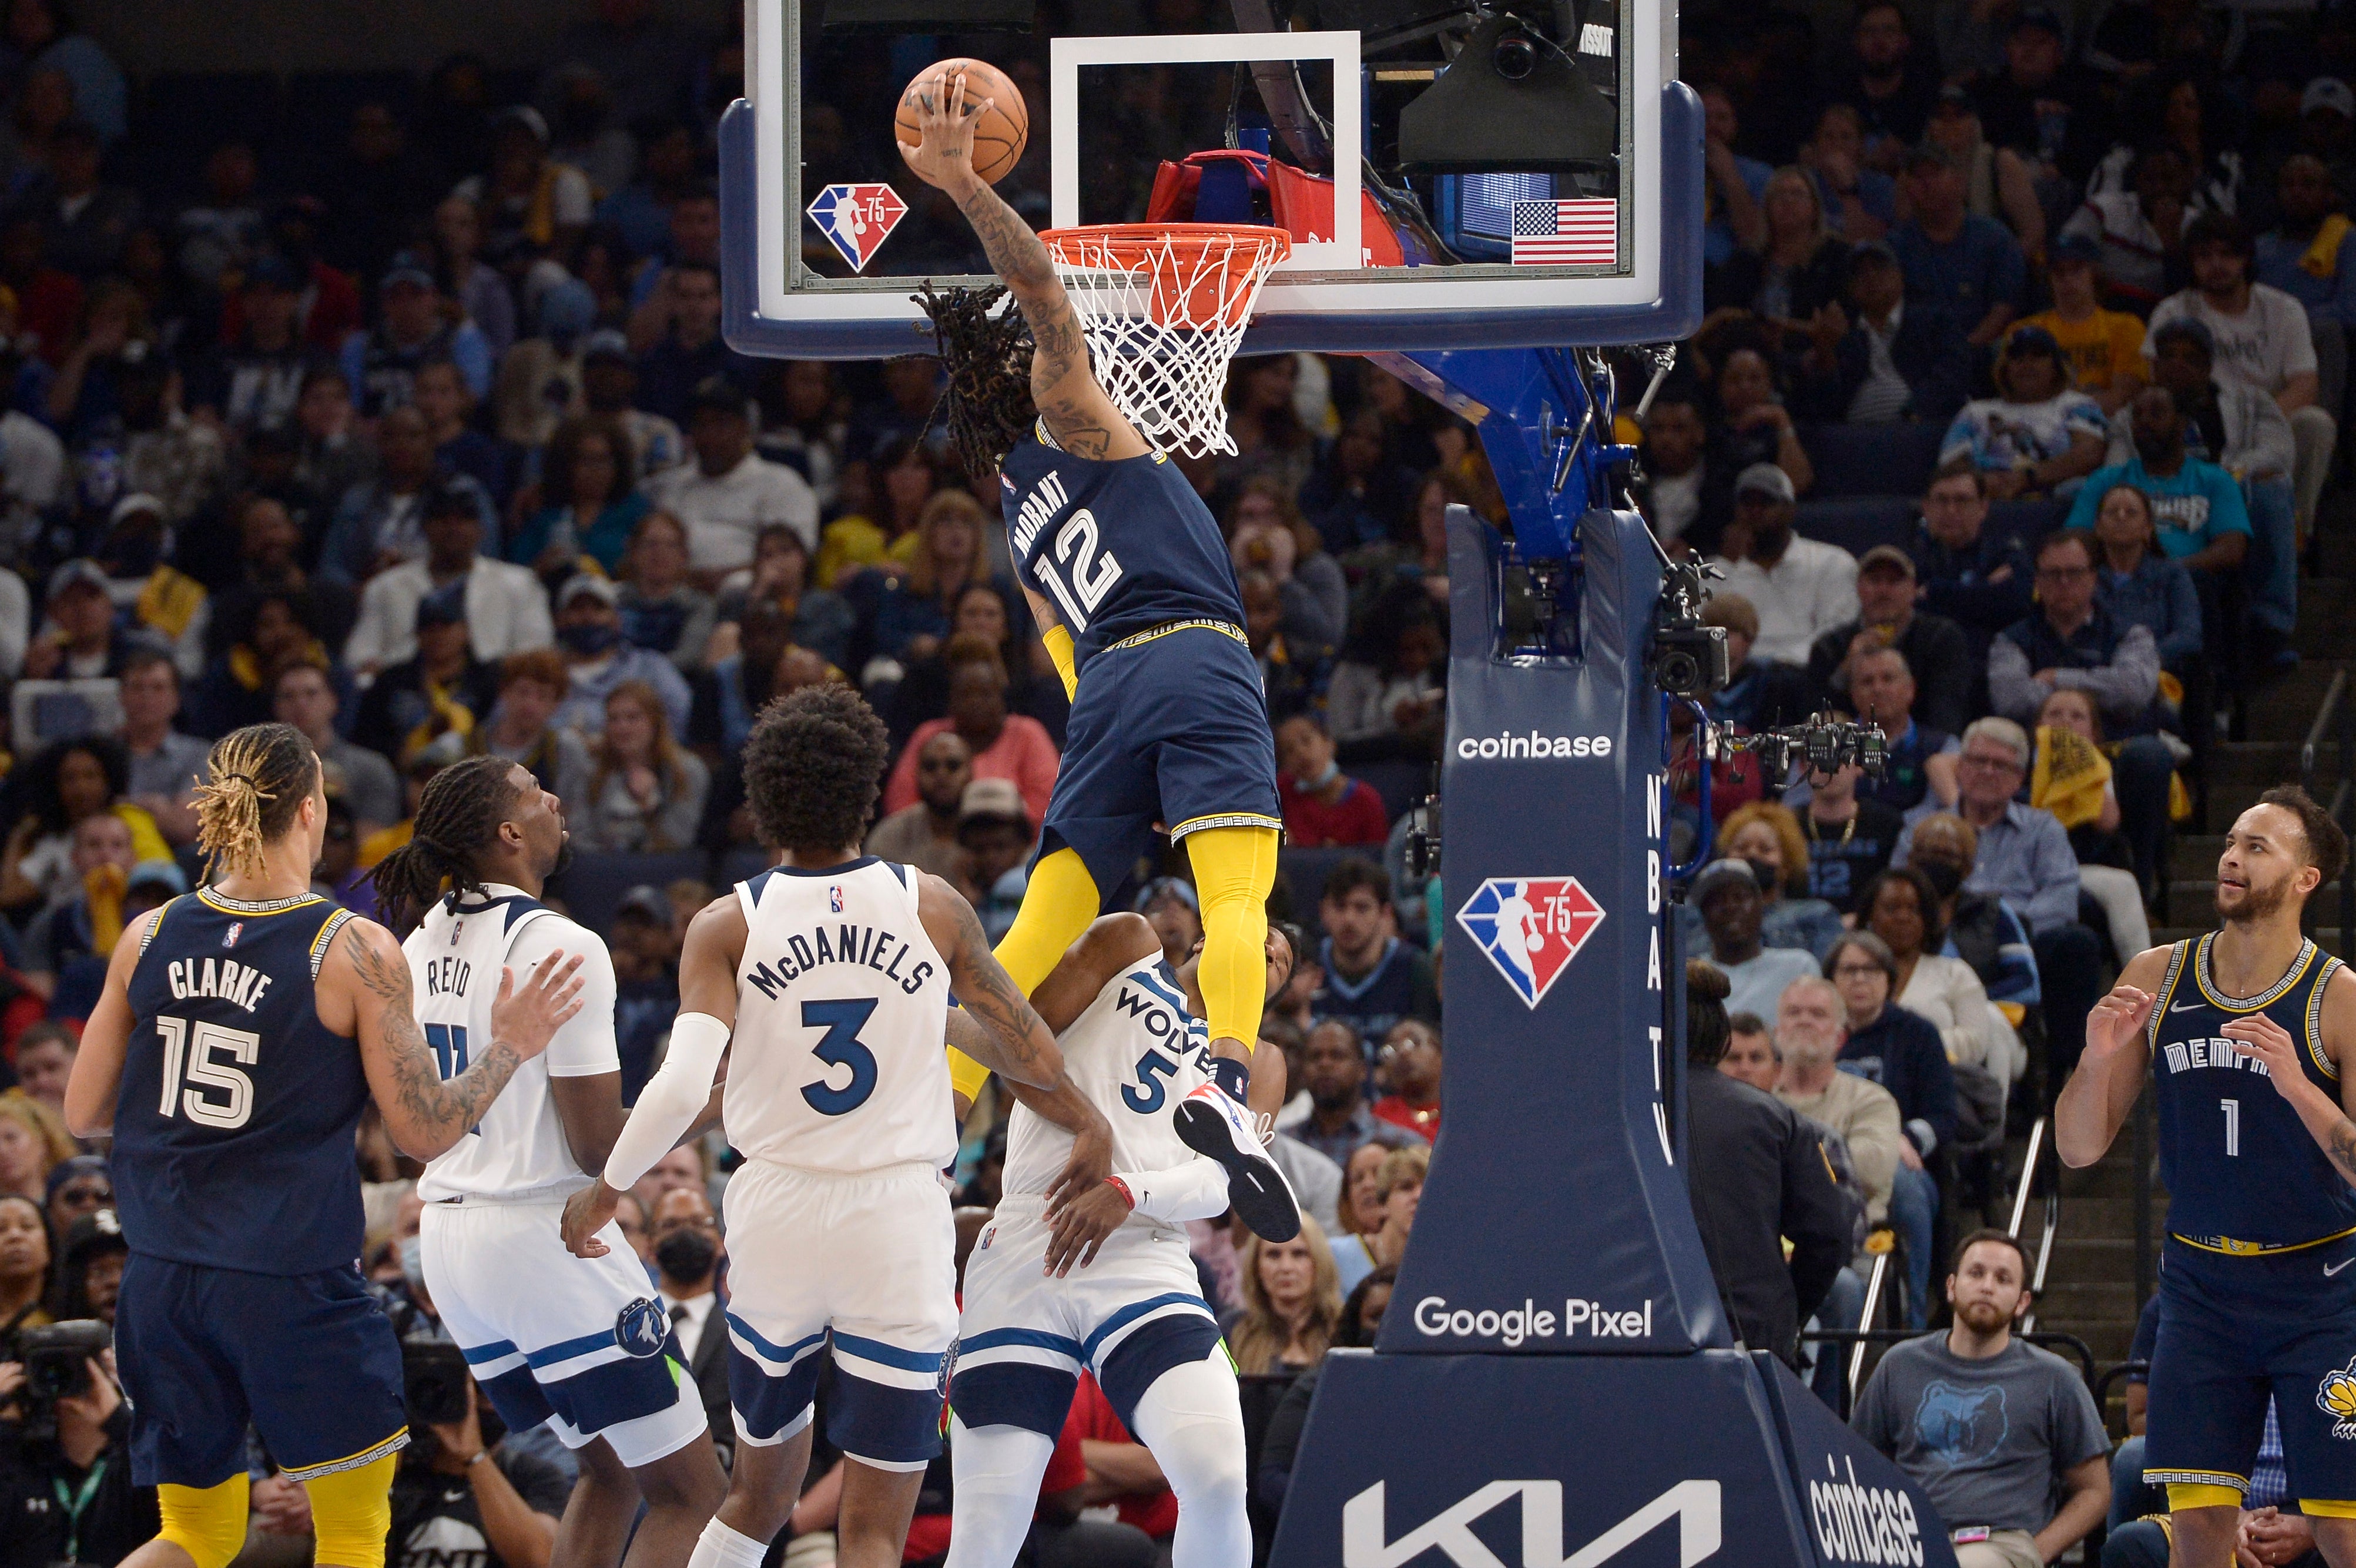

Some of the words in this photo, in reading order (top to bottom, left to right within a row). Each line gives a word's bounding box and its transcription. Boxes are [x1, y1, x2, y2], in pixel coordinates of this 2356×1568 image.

[866, 197, 885, 223] 75
[1013, 470, 1070, 559] MORANT
[1033, 508, 1123, 634] 12
[1457, 730, 1612, 759] coinbase
[1543, 896, 1571, 934] 75
[168, 957, 273, 1013] CLARKE
[427, 956, 471, 998] REID
[746, 923, 934, 1001] McDANIELS
[800, 997, 879, 1116] 3
[1115, 986, 1212, 1076] WOLVE
[156, 1015, 260, 1130] 15
[1120, 1048, 1179, 1115] 5
[2220, 1098, 2239, 1156] 1
[1414, 1296, 1556, 1346] Google
[1566, 1299, 1652, 1337] Pixel
[1810, 1453, 1924, 1568] coinbase
